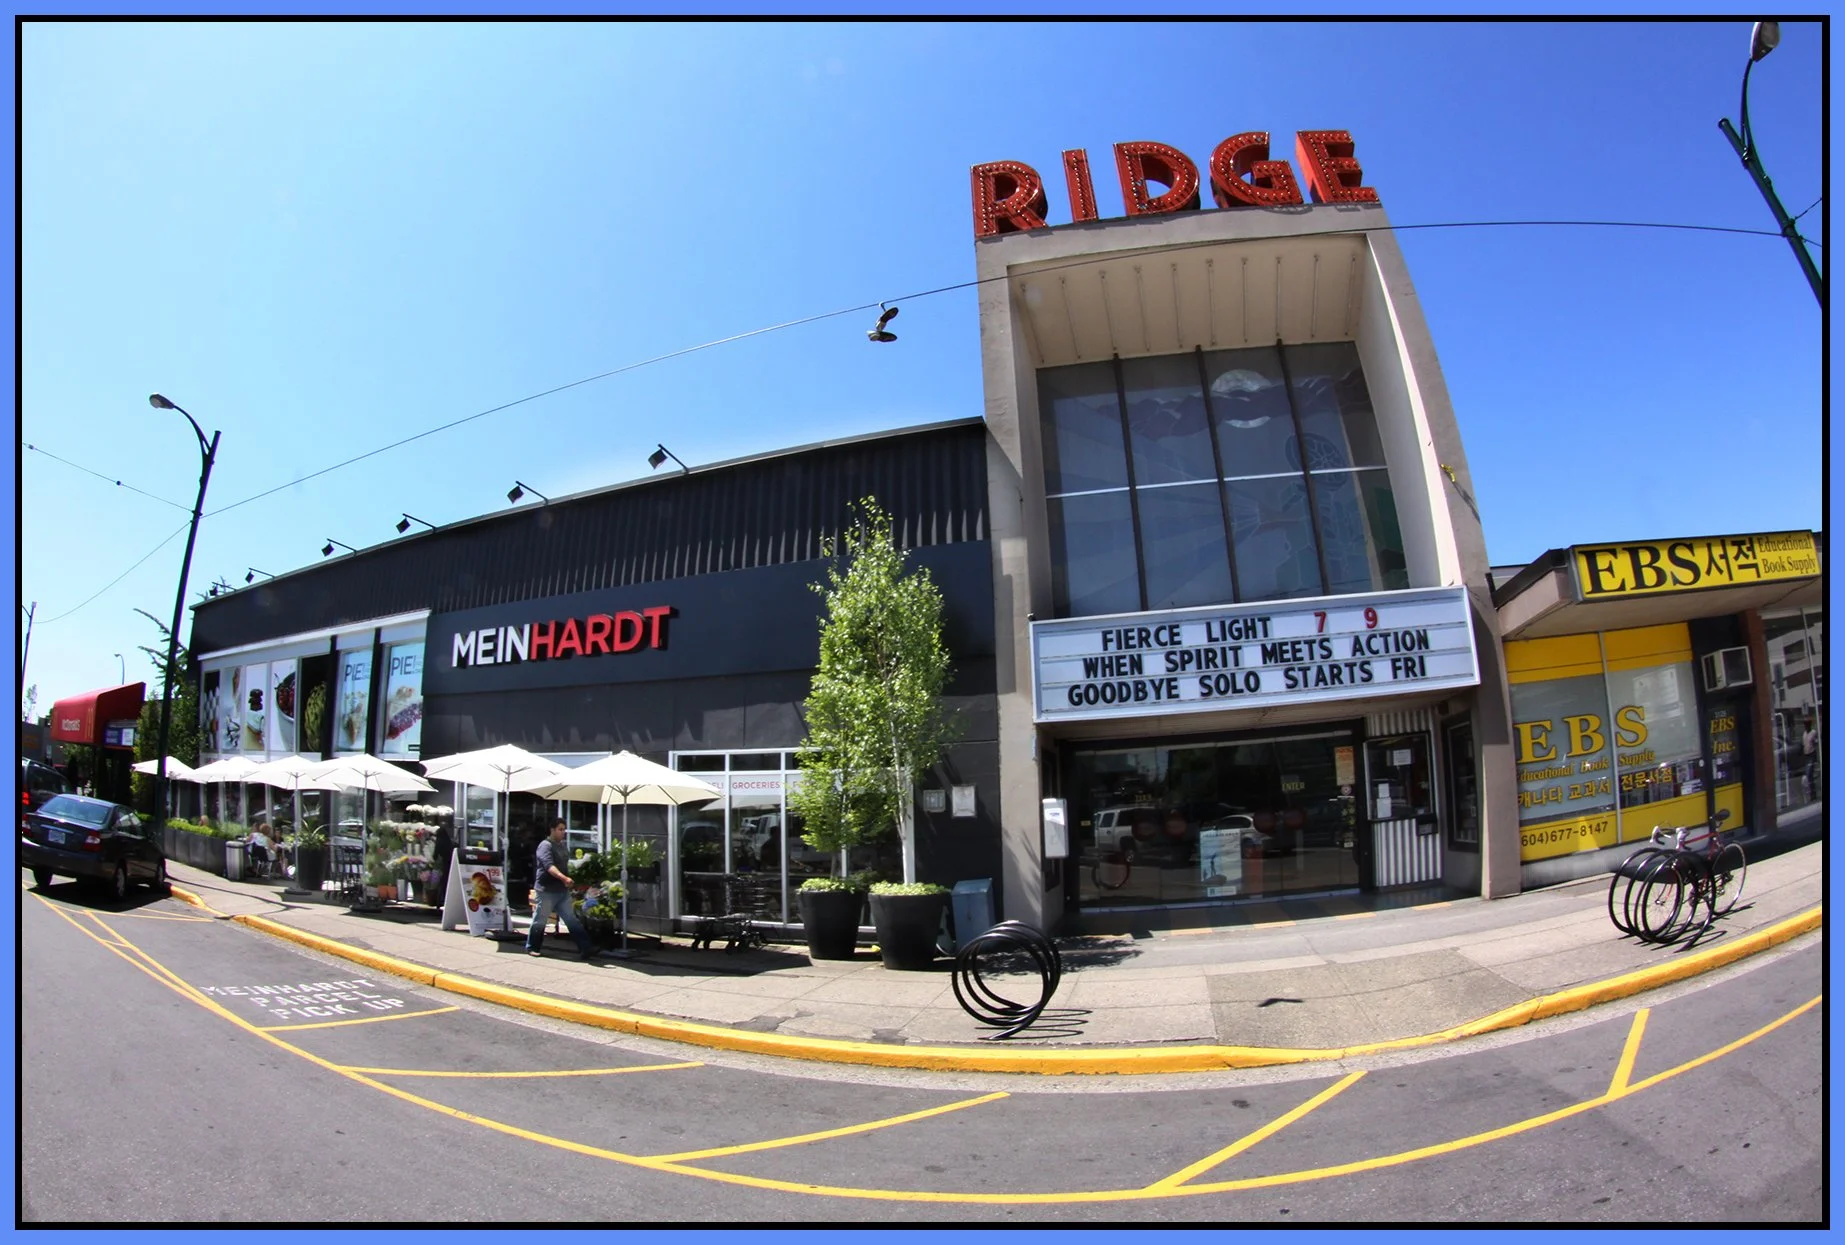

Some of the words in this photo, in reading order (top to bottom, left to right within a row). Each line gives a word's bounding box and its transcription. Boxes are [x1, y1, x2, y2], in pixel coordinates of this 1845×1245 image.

[970, 130, 1379, 238] RIDGE
[1758, 534, 1813, 552] Educational
[1578, 543, 1702, 595] EBS
[1705, 536, 1761, 581] 서적
[1762, 556, 1787, 574] Book
[1787, 555, 1816, 575] Supply
[452, 606, 672, 668] MEINHARDT
[1101, 624, 1182, 652] FIERCE
[1206, 617, 1271, 643] LIGHT
[1314, 611, 1327, 633] 7
[1364, 607, 1378, 629] 9
[1083, 653, 1143, 679] WHEN
[1165, 646, 1242, 672] SPIRIT
[1261, 637, 1333, 665] MEETS
[1351, 629, 1430, 657] ACTION
[1068, 678, 1180, 707] GOODBYE
[1199, 671, 1260, 697] SOLO
[1284, 661, 1374, 690] STARTS
[1391, 656, 1426, 680] FRI
[1515, 705, 1648, 764] EBS
[1711, 716, 1735, 735] EBS
[1712, 741, 1736, 755] Inc.
[1517, 766, 1574, 783] ducational
[1581, 758, 1609, 773] Book
[1618, 750, 1656, 768] Supply
[732, 781, 780, 789] GROCERIES
[1569, 779, 1612, 800] 교과서
[1520, 821, 1609, 847] 604)677-8147
[201, 979, 375, 996] MEINHARDT
[250, 990, 381, 1007] PARCEL
[269, 1004, 359, 1019] PICK
[362, 998, 404, 1010] UP
